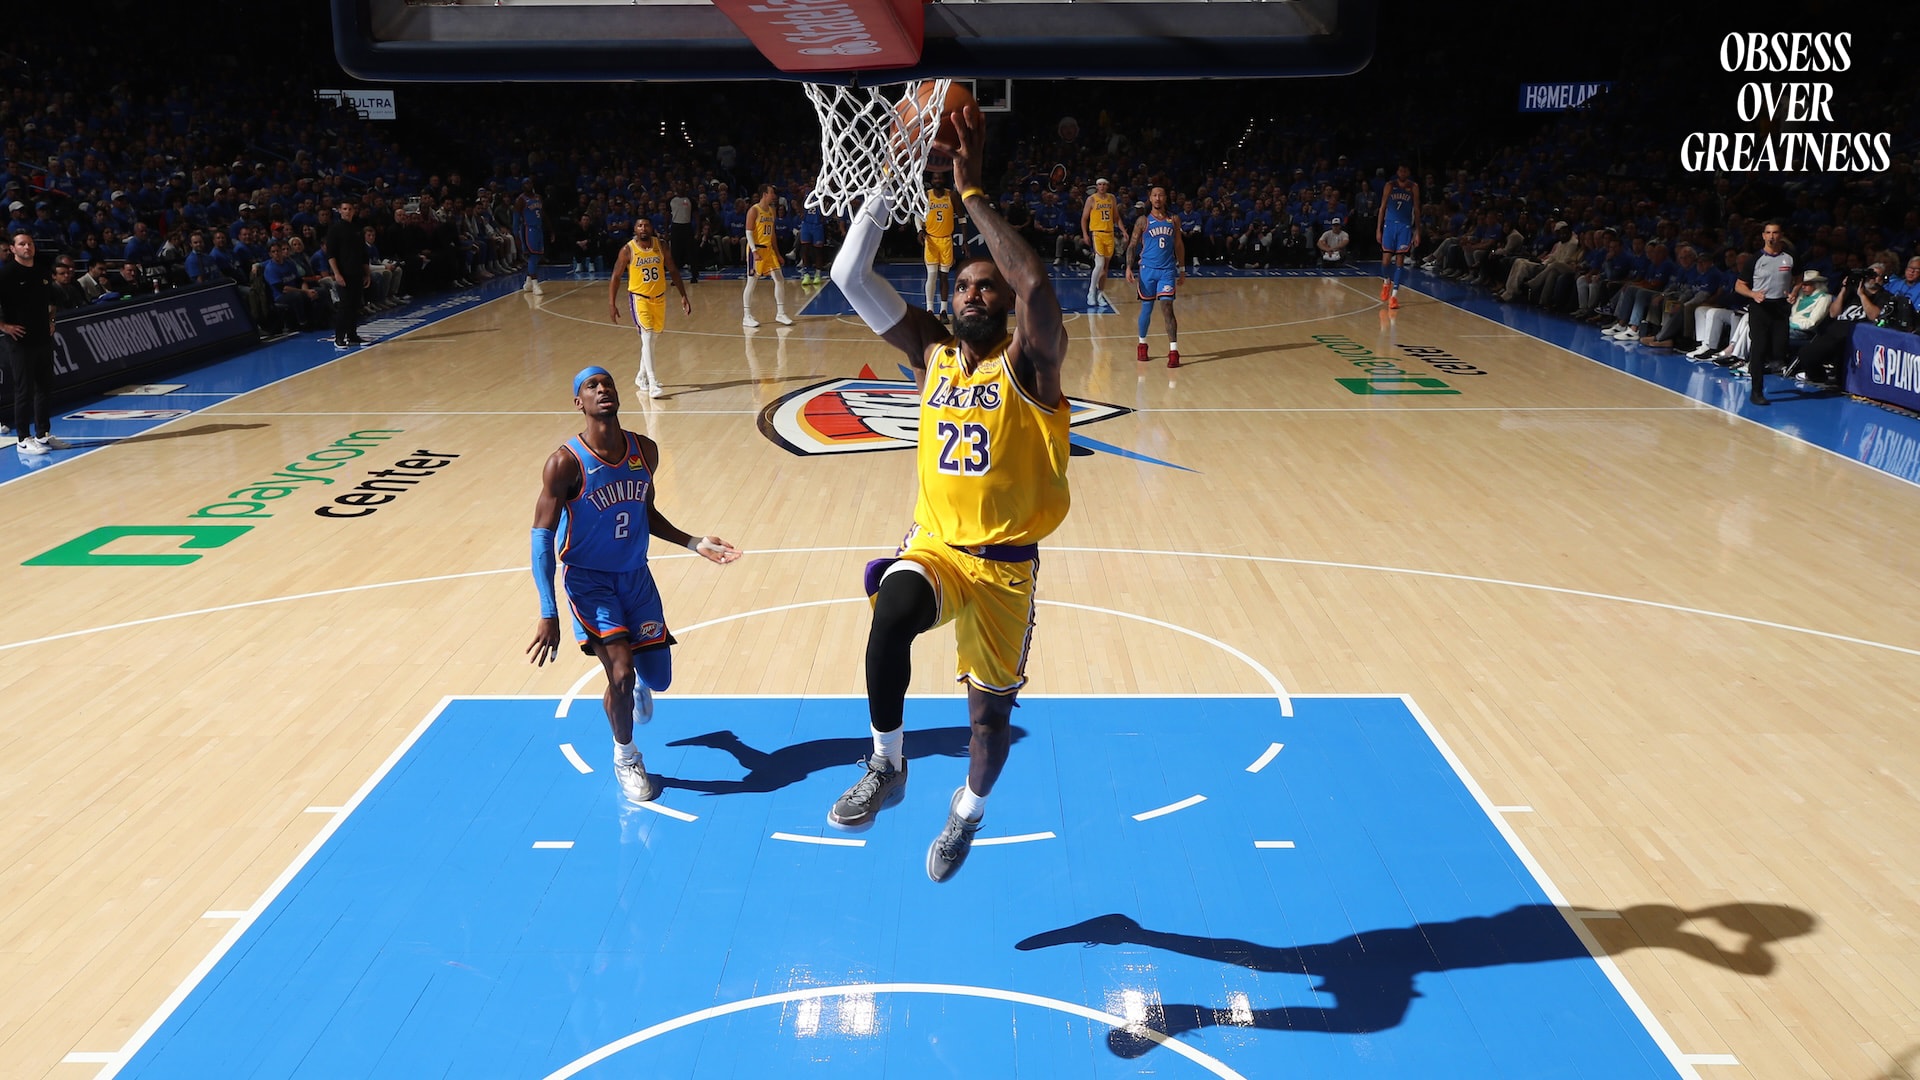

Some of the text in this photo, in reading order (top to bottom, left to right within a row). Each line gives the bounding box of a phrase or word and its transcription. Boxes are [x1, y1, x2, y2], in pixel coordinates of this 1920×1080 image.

[354, 98, 392, 109] ULTRA
[1100, 210, 1111, 222] 15
[1396, 201, 1403, 210] 7
[935, 210, 944, 223] 5
[763, 224, 773, 236] 10
[1148, 226, 1174, 238] THUNDER
[1158, 237, 1166, 249] 6
[635, 256, 662, 267] LAKERS
[641, 266, 660, 283] 36
[200, 302, 235, 327] ESPN
[55, 332, 80, 373] 2
[76, 309, 162, 364] TOMORROW
[152, 308, 185, 345] 7PM
[175, 307, 199, 340] ET
[1311, 334, 1428, 375] paycom
[1394, 343, 1489, 376] center
[936, 420, 992, 478] 23
[188, 429, 404, 519] paycom
[314, 448, 460, 518] center
[588, 480, 649, 512] THUNDER
[614, 511, 630, 540] 2
